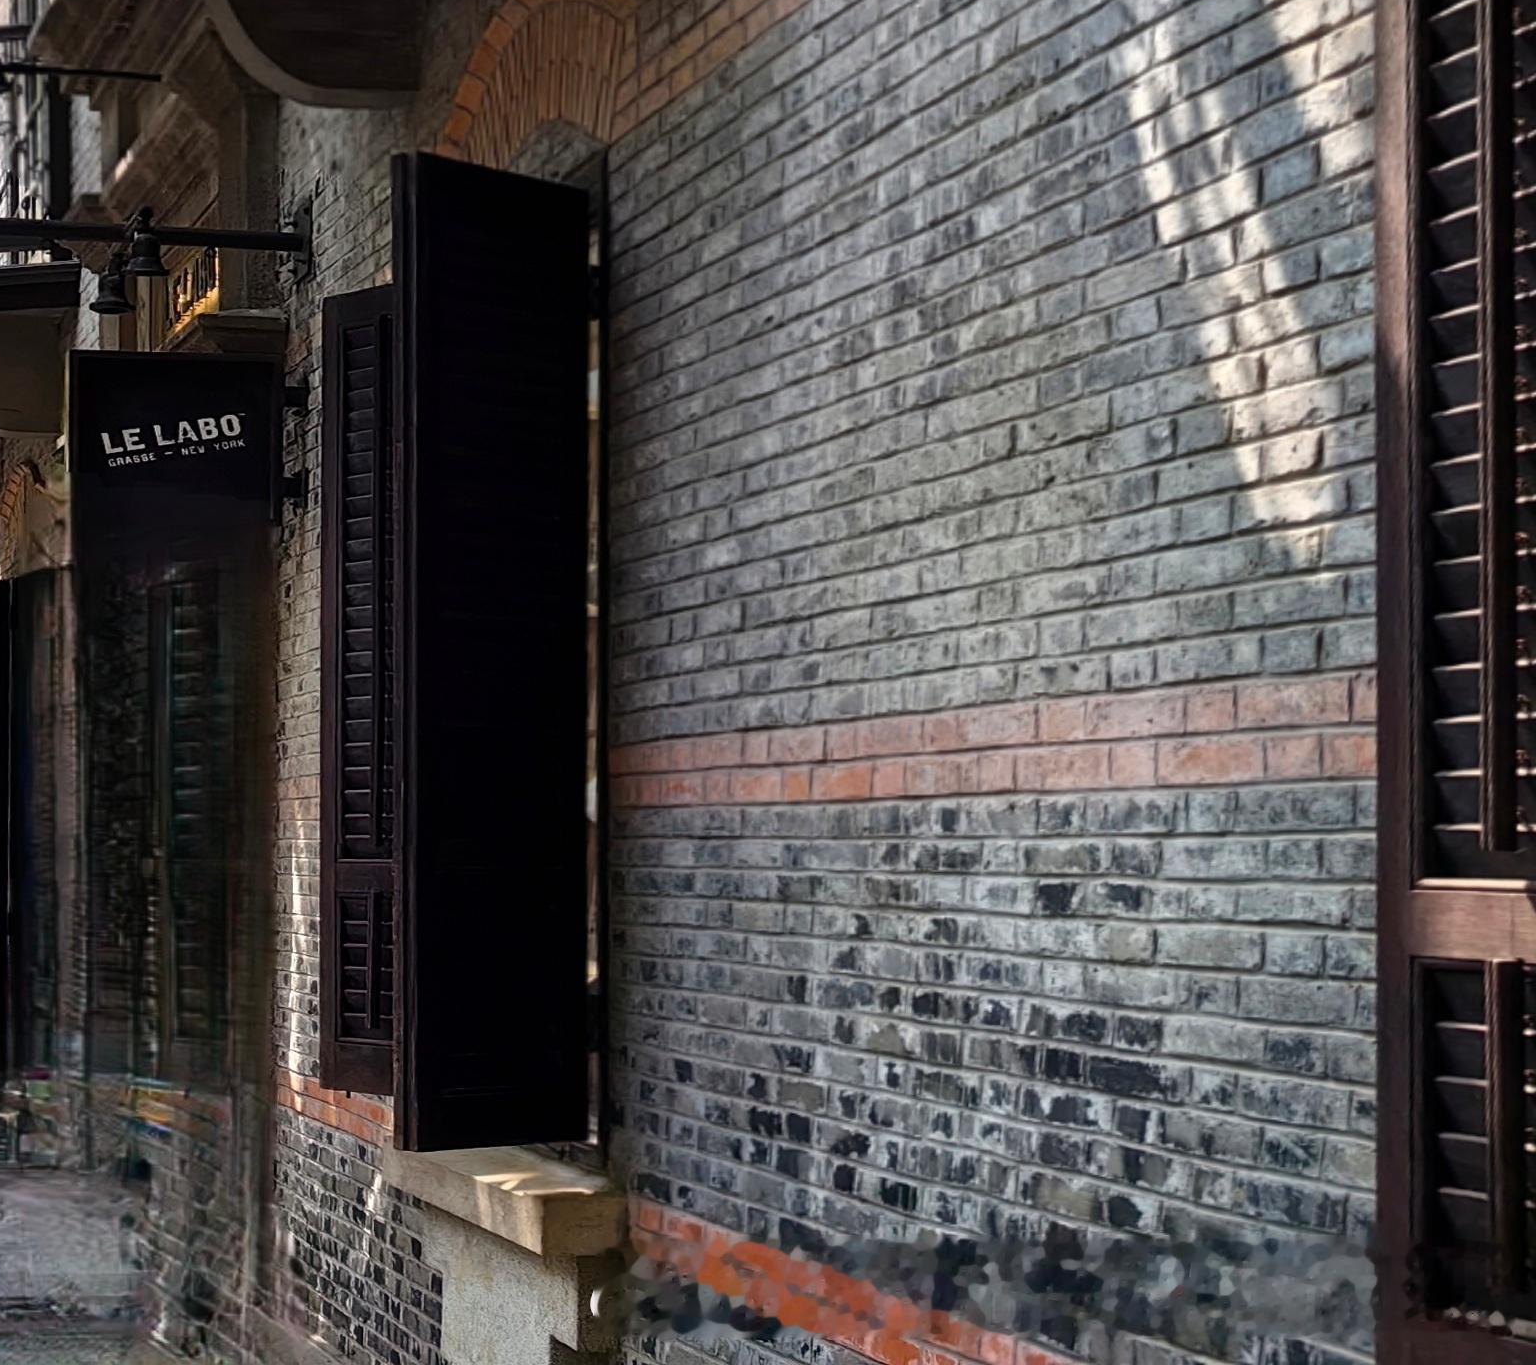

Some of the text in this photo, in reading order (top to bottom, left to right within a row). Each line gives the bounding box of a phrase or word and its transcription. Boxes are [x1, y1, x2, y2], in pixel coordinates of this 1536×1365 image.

[100, 414, 241, 454] LE LABO
[181, 445, 205, 456] NEW
[213, 438, 246, 451] YORK
